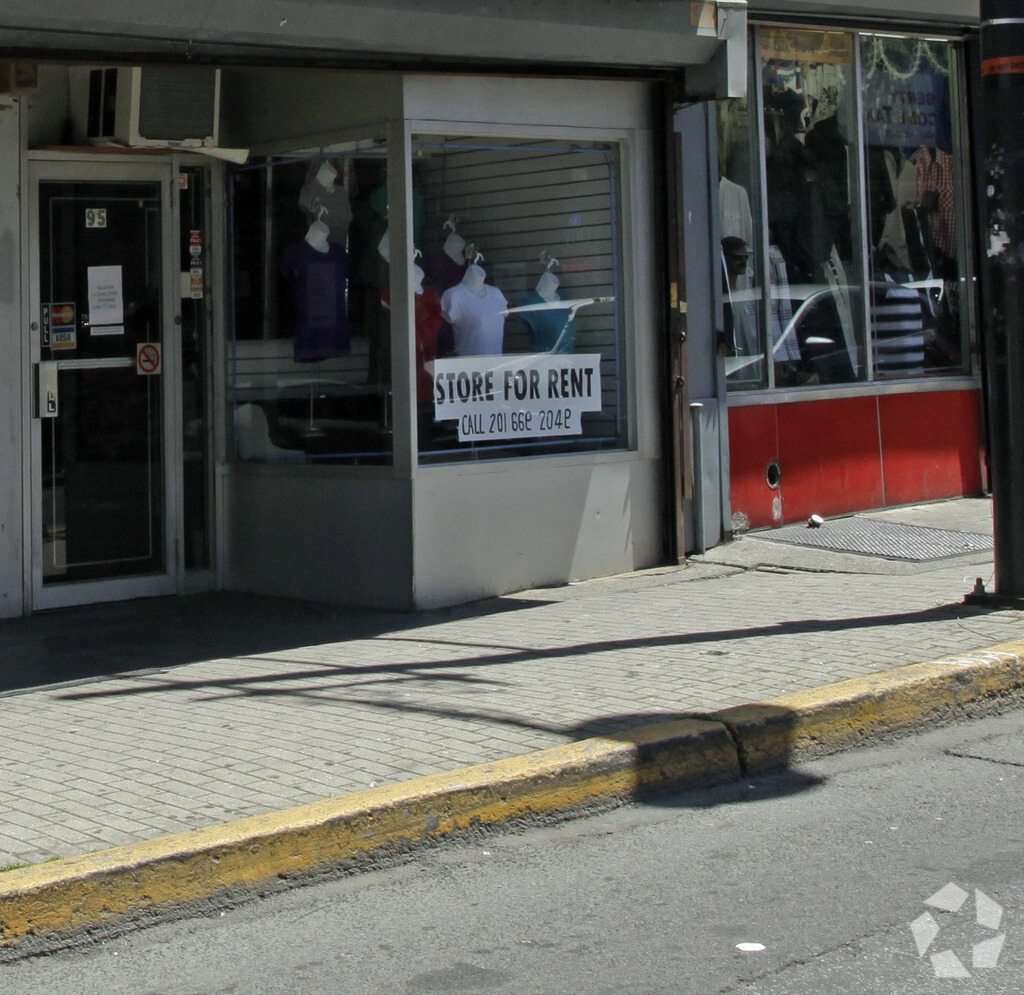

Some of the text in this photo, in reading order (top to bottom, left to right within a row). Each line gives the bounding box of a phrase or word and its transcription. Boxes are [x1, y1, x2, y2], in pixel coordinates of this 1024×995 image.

[87, 210, 105, 226] 95
[55, 334, 72, 343] VISA
[436, 368, 594, 405] STORE FOR RENT
[463, 414, 485, 436] CALL
[490, 412, 507, 433] 201
